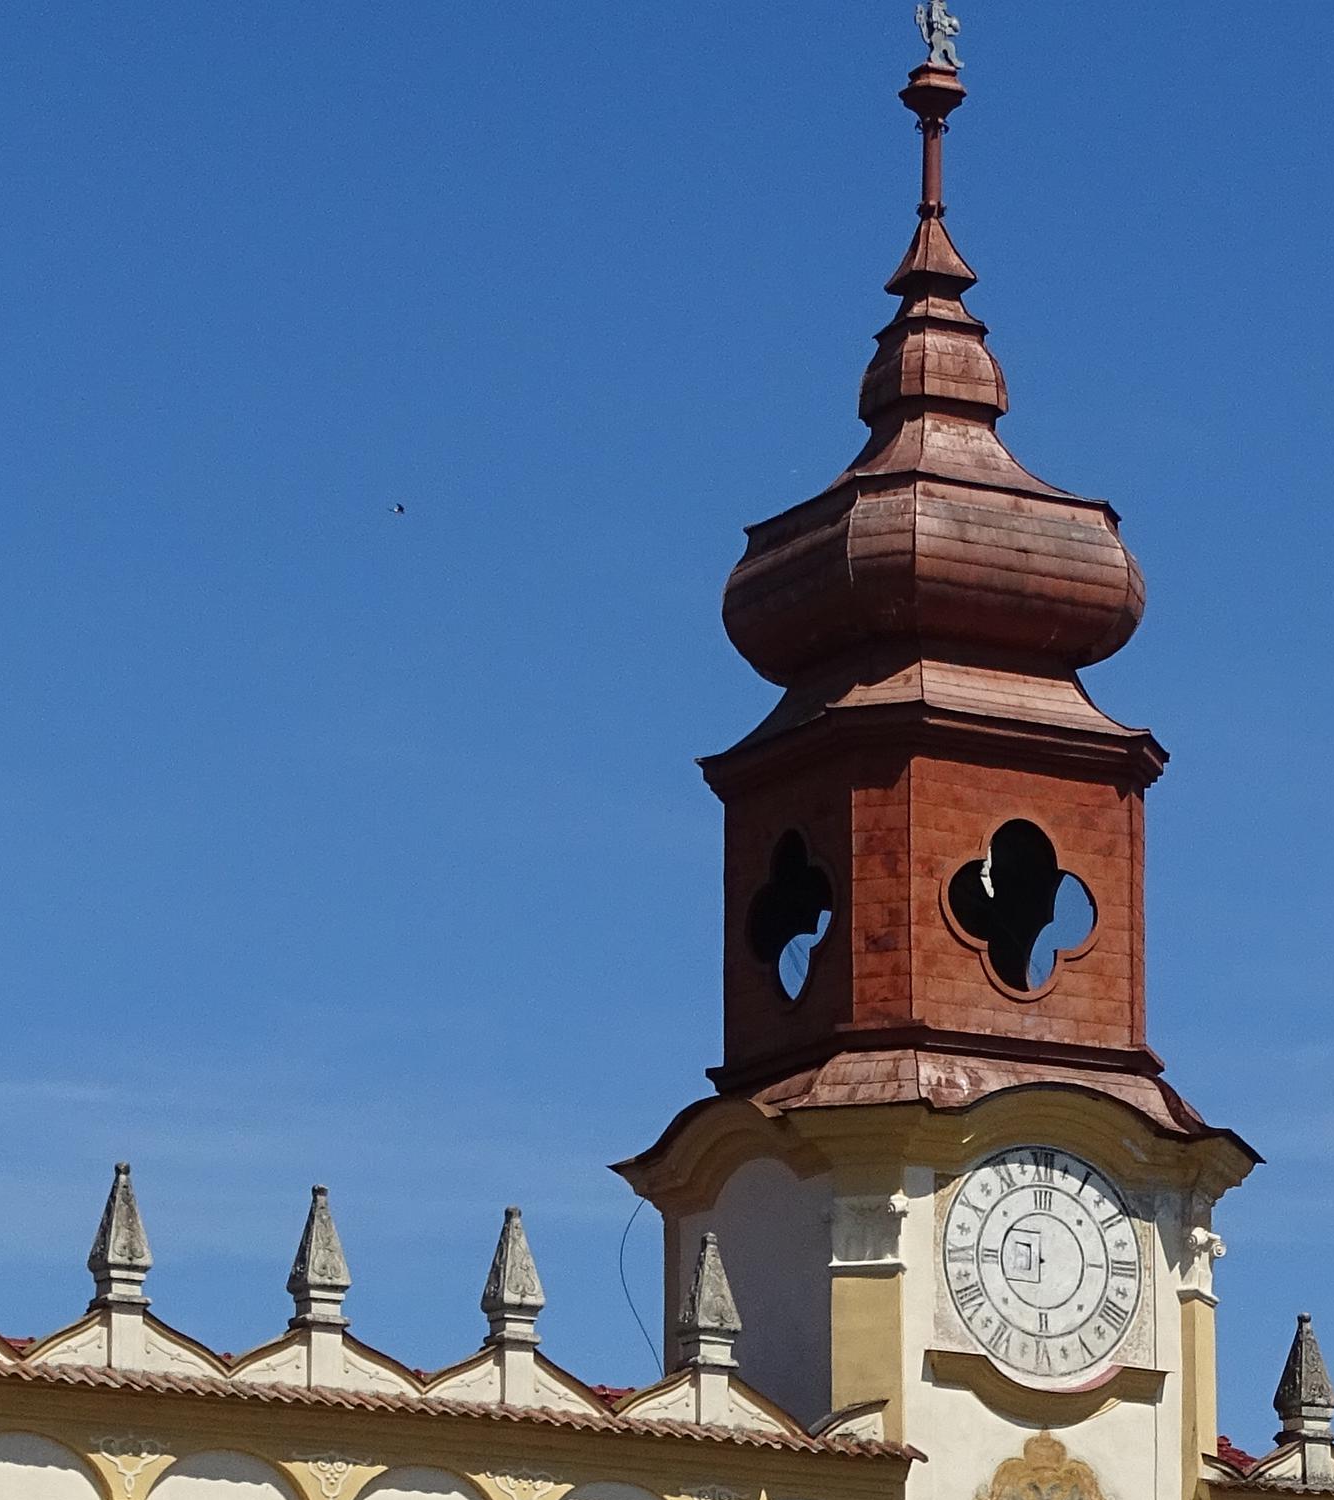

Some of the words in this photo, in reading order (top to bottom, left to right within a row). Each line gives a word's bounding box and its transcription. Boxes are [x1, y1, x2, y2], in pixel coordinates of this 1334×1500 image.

[992, 1158, 1016, 1194] XI
[1030, 1151, 1055, 1184] XII
[1076, 1171, 1093, 1197] I
[958, 1191, 986, 1221] X
[1099, 1213, 1124, 1232] II
[1078, 1333, 1096, 1363] V
